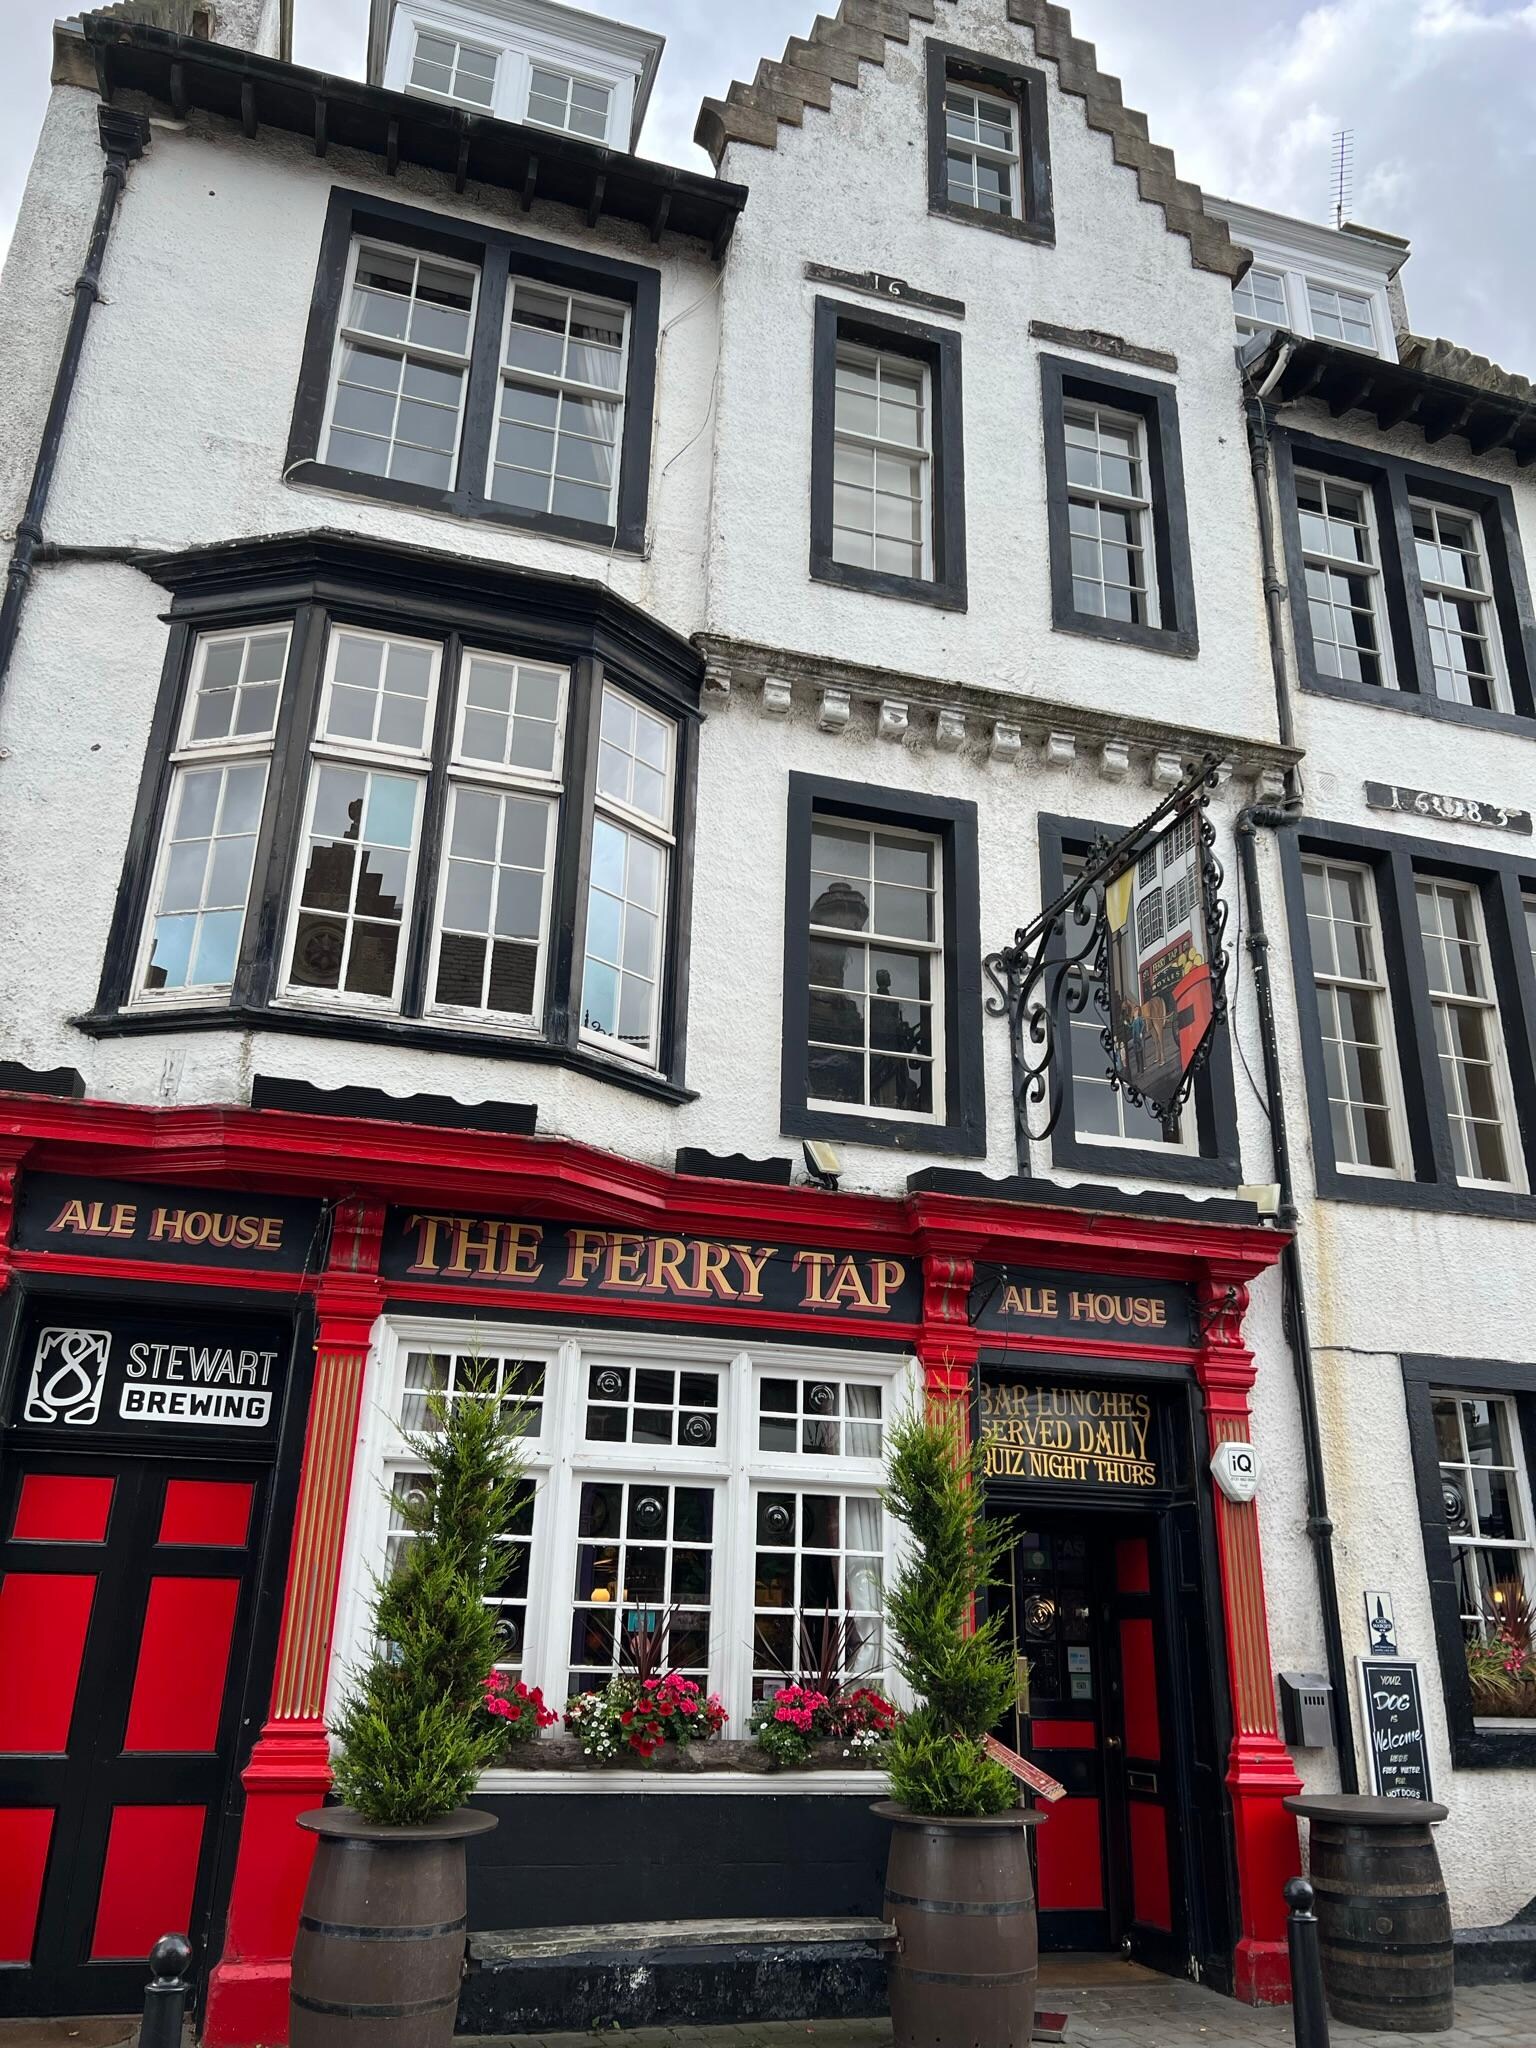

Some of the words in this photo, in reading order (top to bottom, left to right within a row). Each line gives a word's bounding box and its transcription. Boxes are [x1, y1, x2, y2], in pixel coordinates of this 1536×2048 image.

[47, 1199, 137, 1239] ALE
[147, 1207, 284, 1252] HOUSE
[404, 1213, 544, 1284] THE
[559, 1227, 779, 1303] FERRY
[791, 1250, 907, 1314] TAP
[997, 1285, 1058, 1319] ALE
[1069, 1291, 1167, 1328] HOUSE
[126, 1342, 278, 1386] STEWART
[125, 1389, 265, 1421] BREWING
[980, 1382, 1030, 1418] BAR
[1035, 1386, 1151, 1418] LUNCHES
[981, 1416, 1072, 1450] SERVED
[1078, 1414, 1150, 1461] DAILY
[1029, 1451, 1089, 1480] NIGHT
[1093, 1459, 1156, 1486] THURS
[1380, 1675, 1402, 1686] YOUR
[1373, 1691, 1410, 1711] DOG
[1373, 1728, 1423, 1753] Welcome
[1401, 1788, 1421, 1799] DOGS
